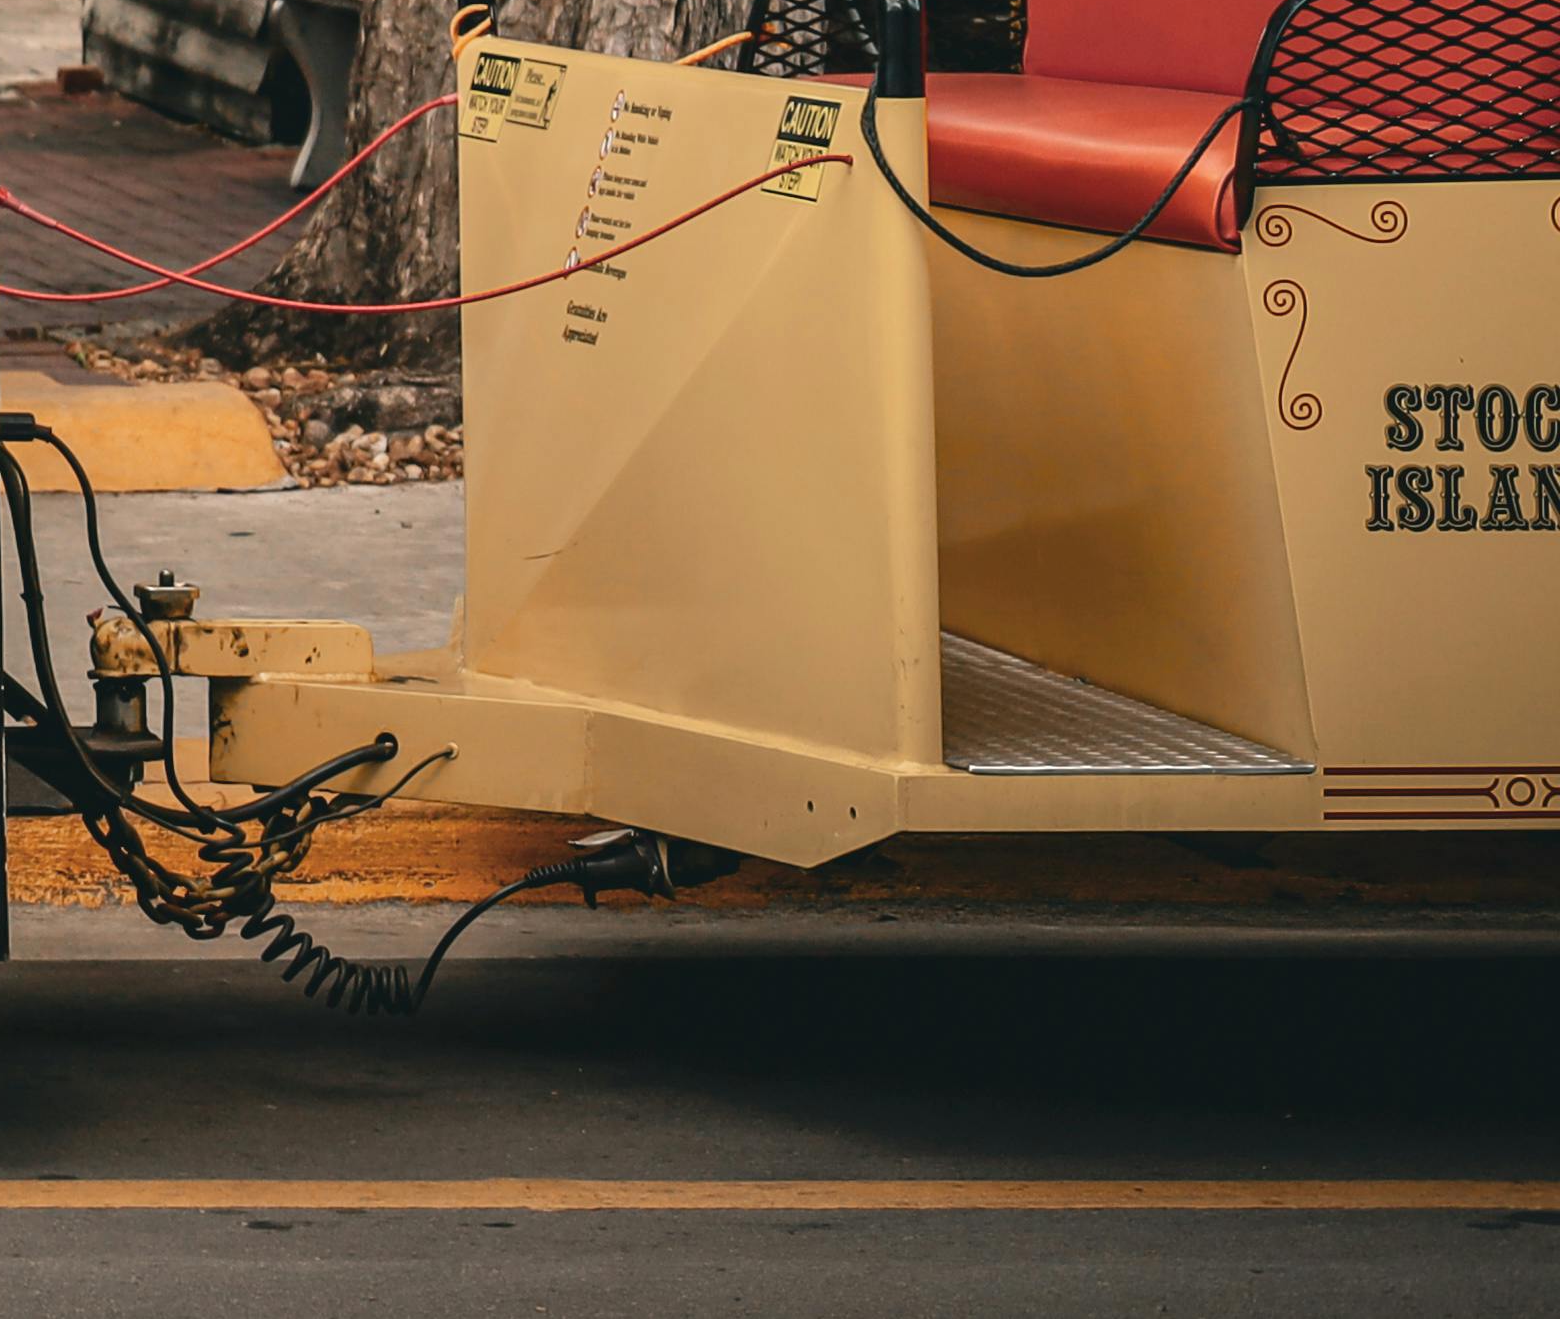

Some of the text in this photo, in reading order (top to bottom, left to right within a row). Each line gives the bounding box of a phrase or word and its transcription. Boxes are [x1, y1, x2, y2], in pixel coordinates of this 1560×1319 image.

[474, 56, 519, 90] CAUTION
[781, 101, 839, 140] CAUTION
[1384, 384, 1560, 452] STOC
[1365, 464, 1560, 532] ISLAN
